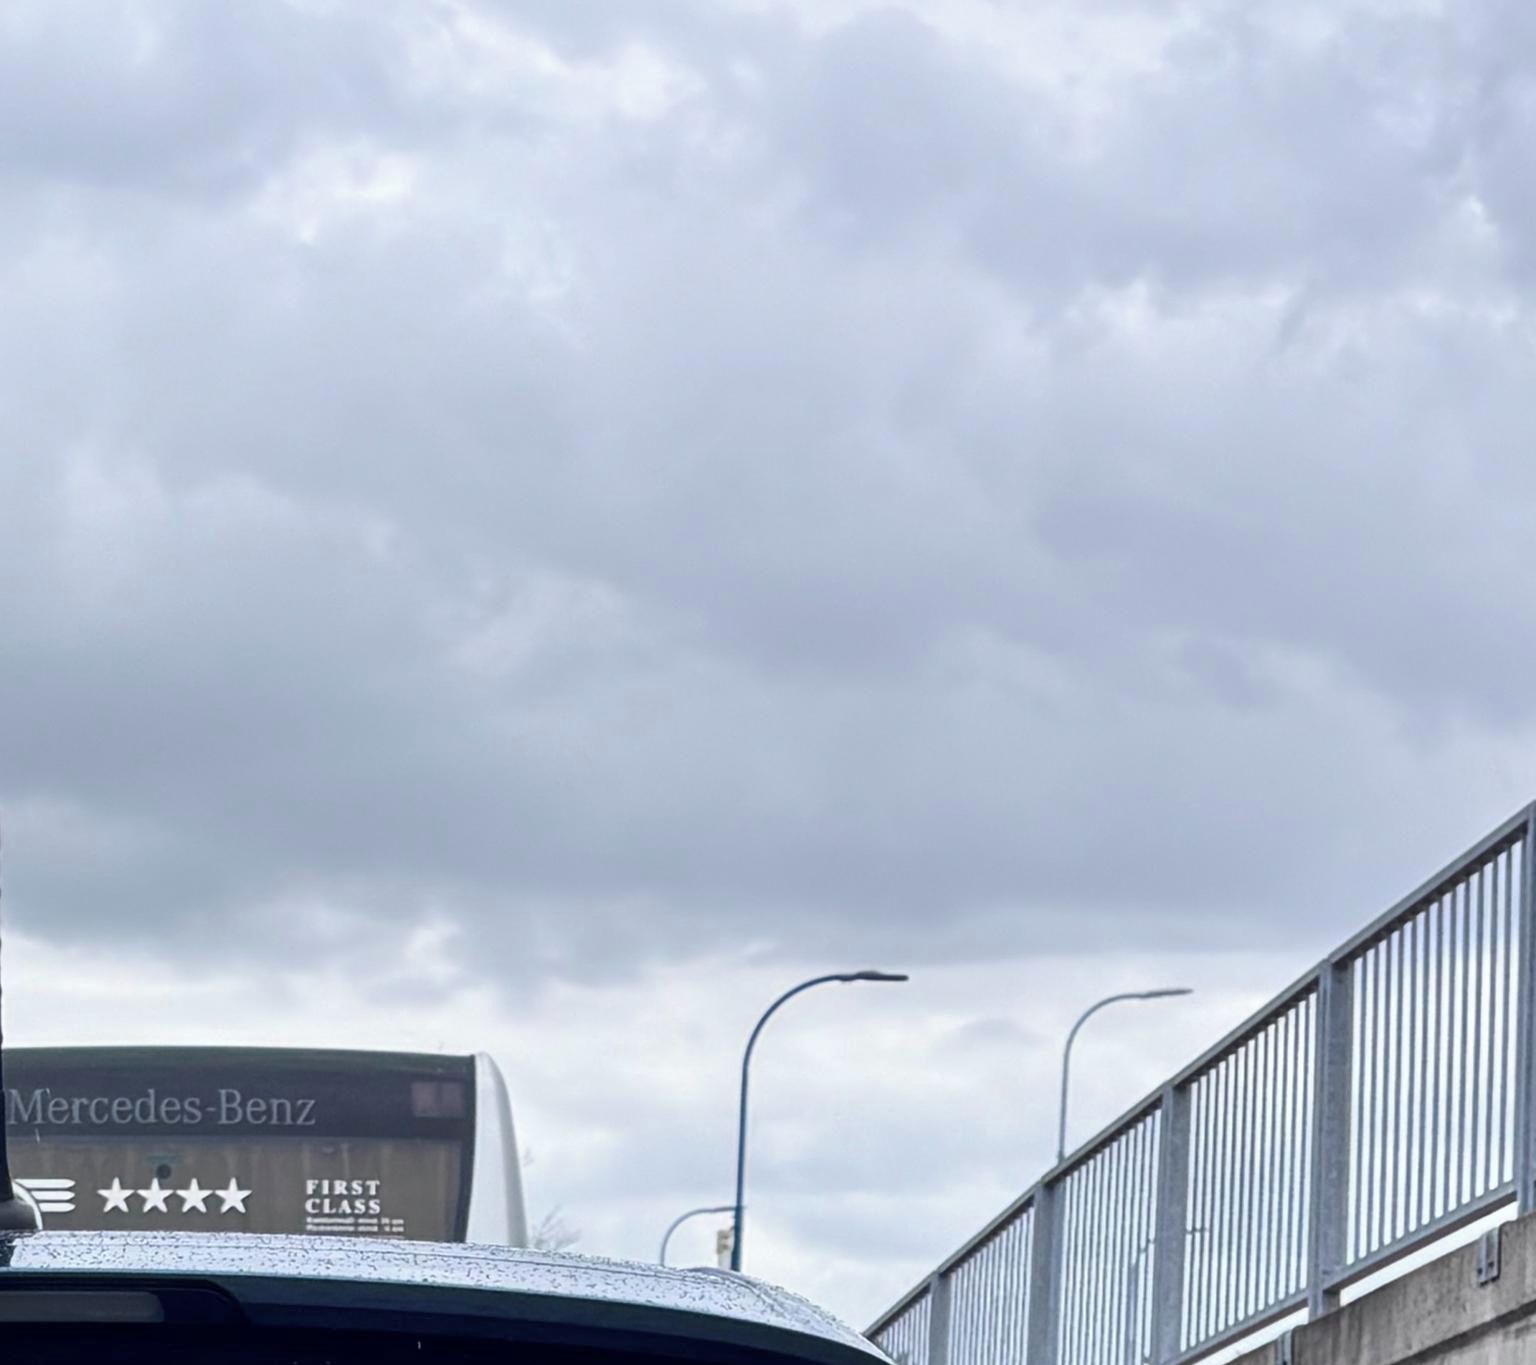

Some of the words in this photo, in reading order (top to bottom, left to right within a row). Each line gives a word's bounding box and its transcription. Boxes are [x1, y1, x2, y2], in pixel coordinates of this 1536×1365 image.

[7, 1088, 316, 1125] Mercedes-Benz
[306, 1179, 380, 1195] FIRST
[305, 1198, 381, 1214] CLASS
